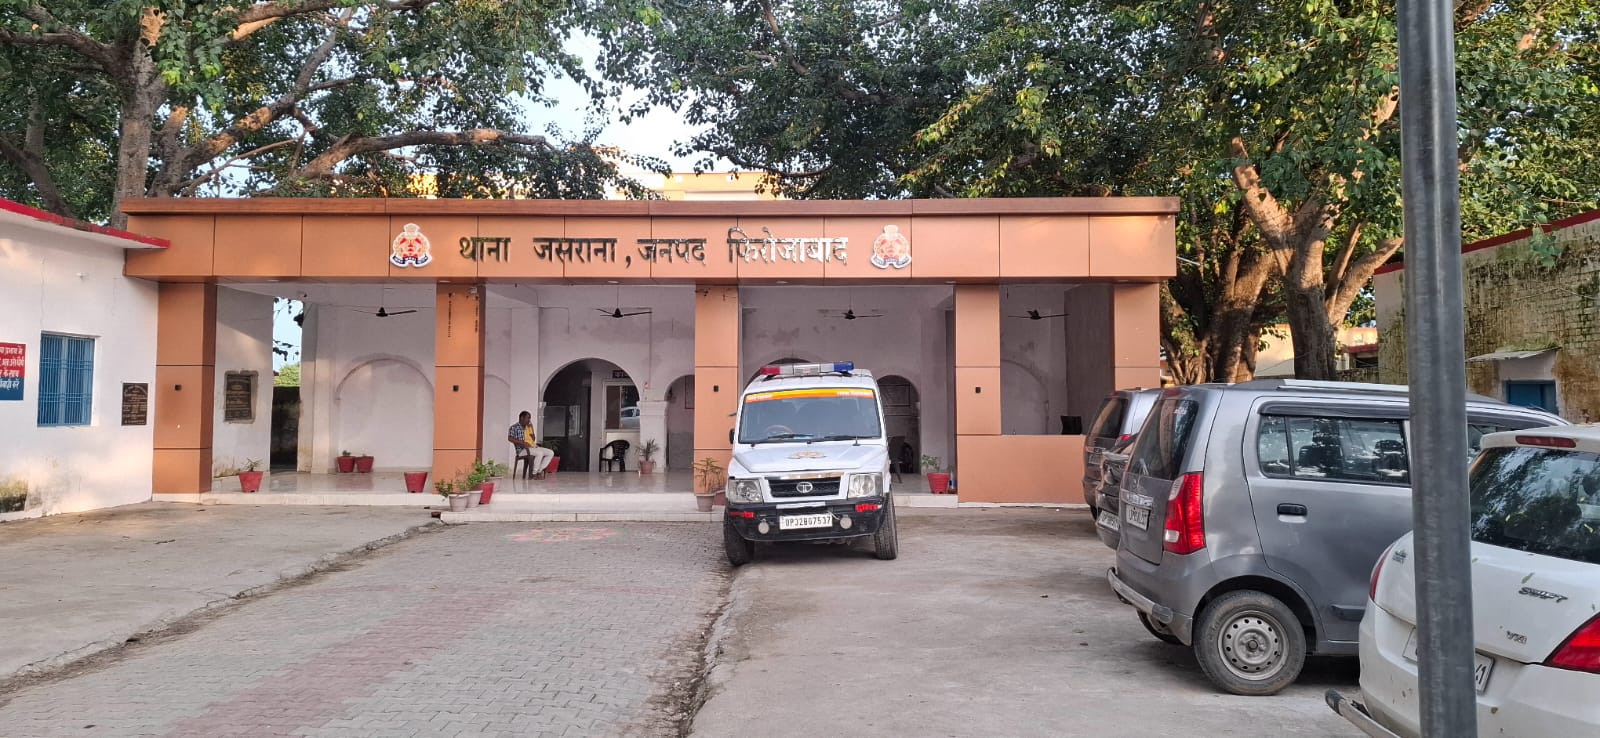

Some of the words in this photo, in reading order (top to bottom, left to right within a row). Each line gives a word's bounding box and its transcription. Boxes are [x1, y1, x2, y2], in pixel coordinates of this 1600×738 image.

[459, 236, 511, 263] थाना
[636, 237, 707, 265] जनपद
[726, 226, 848, 265] फिरोजाबाद
